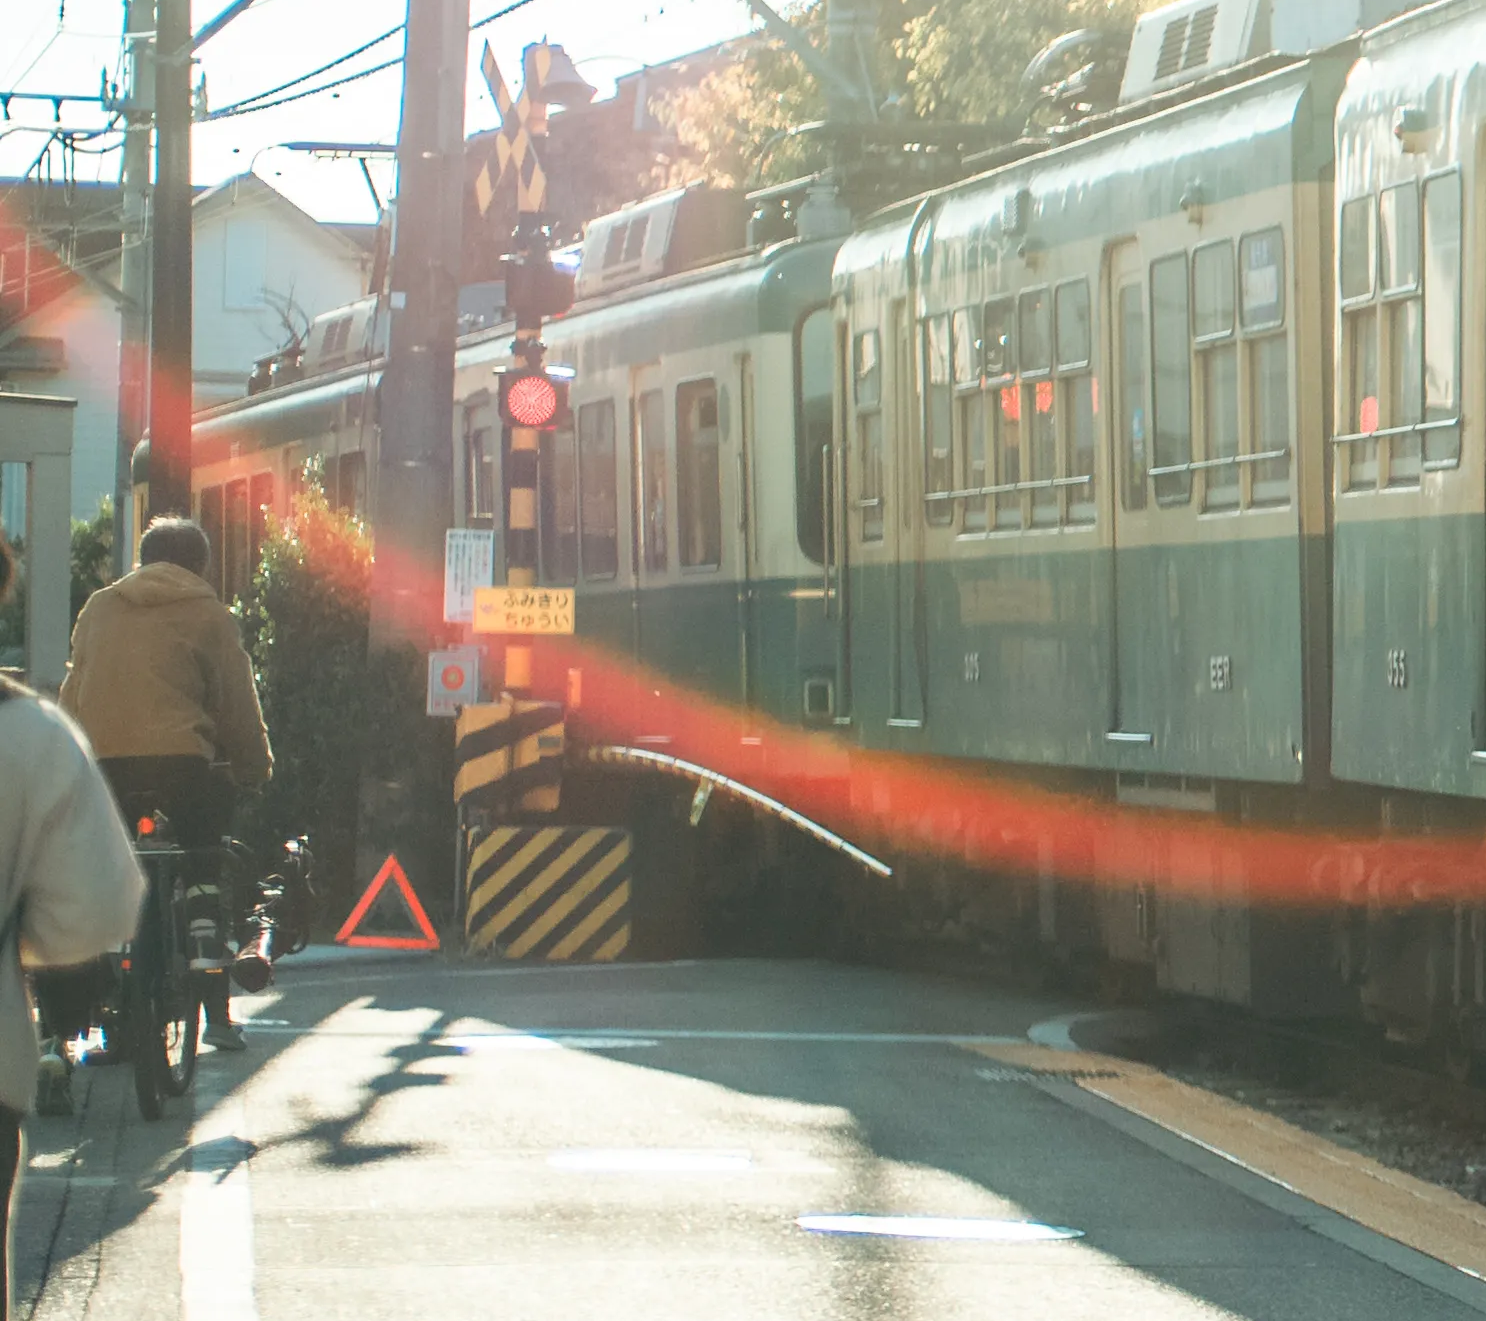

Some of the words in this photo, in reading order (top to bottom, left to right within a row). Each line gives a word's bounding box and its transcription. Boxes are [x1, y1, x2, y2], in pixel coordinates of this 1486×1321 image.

[505, 591, 569, 609] ふみきり
[506, 612, 570, 629] ちゅうい
[1210, 655, 1231, 691] EER
